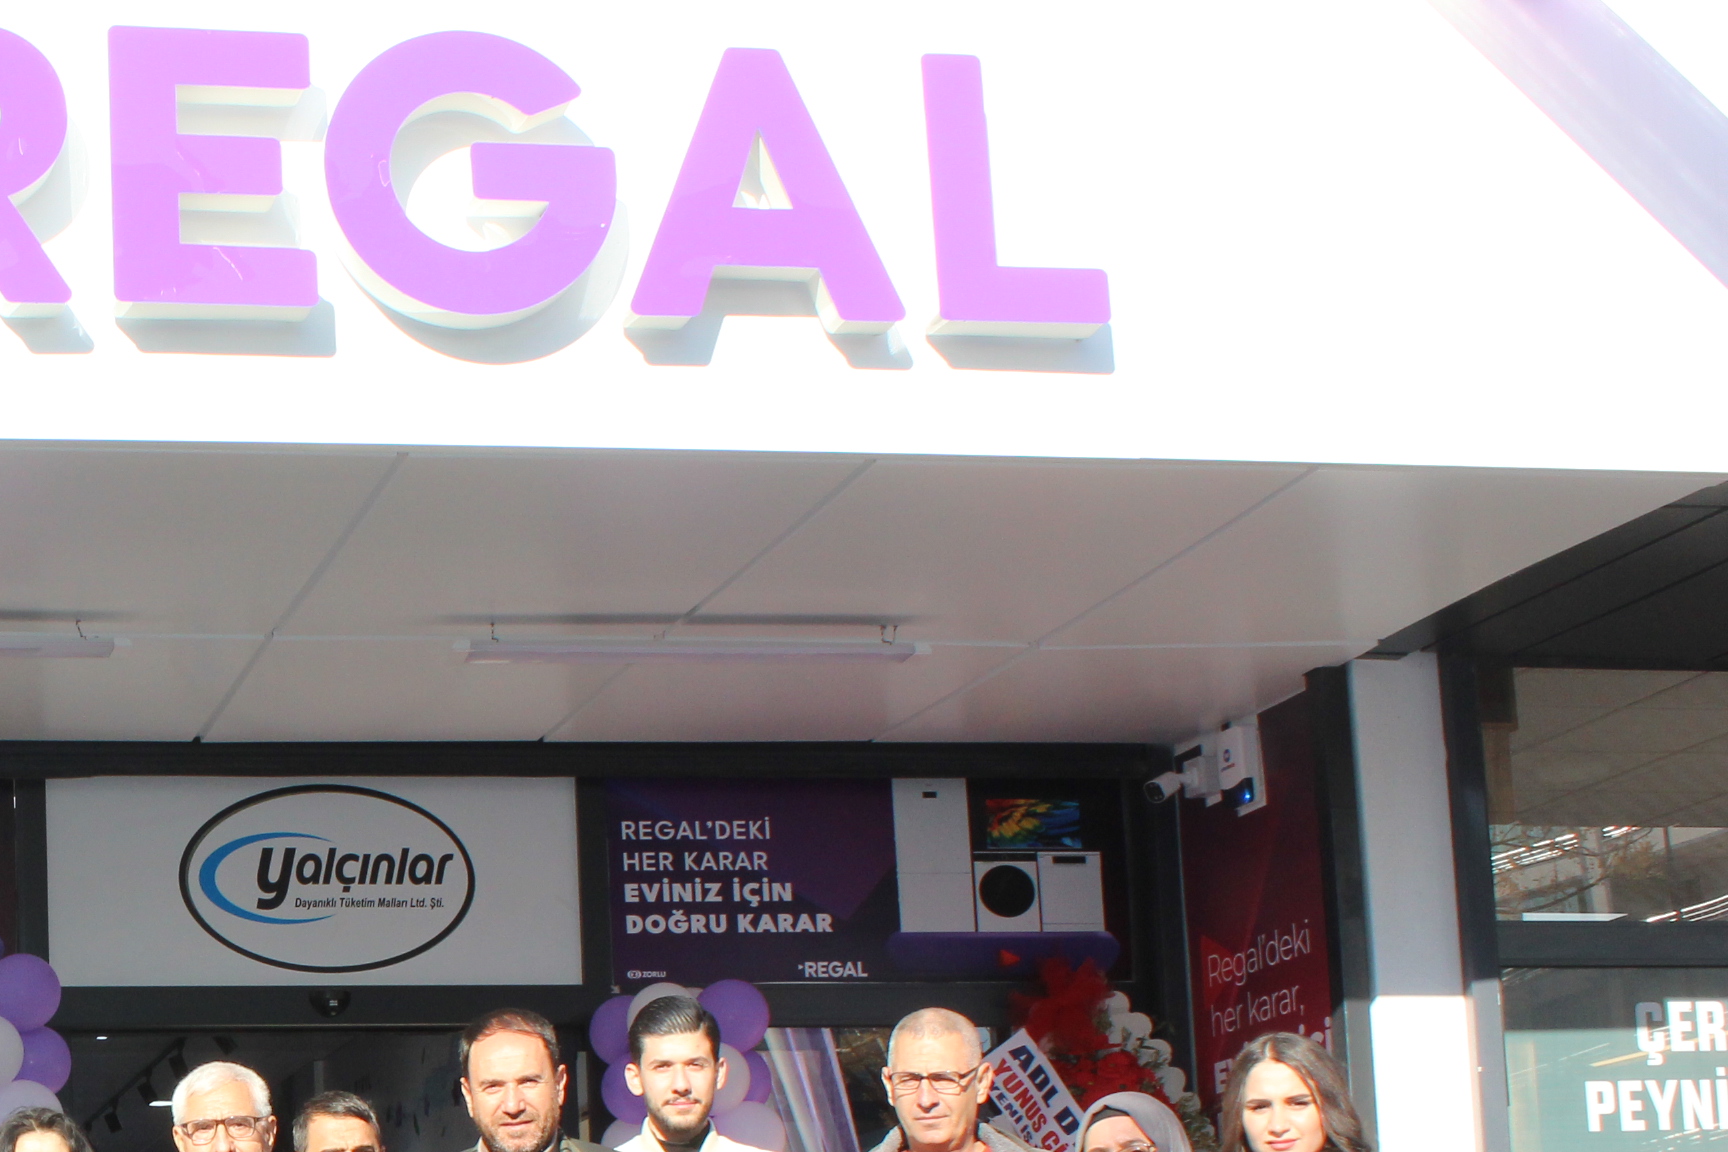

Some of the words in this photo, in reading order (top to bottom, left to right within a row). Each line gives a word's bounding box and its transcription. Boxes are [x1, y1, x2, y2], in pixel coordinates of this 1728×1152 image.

[622, 851, 674, 872] HER
[684, 851, 768, 871] KARAR
[339, 897, 375, 908] Tüketim
[377, 897, 408, 908] Malları
[410, 897, 427, 908] Ltd.
[429, 897, 445, 910] Şti.
[623, 877, 723, 904] EVİNİZ
[732, 876, 793, 908] İÇİN
[625, 910, 727, 934] DOĞRU
[737, 913, 834, 934] KARAR
[804, 961, 869, 978] REGAL
[1210, 1003, 1243, 1037] her
[1247, 985, 1305, 1026] karar,
[993, 1058, 1047, 1133] YUNUS
